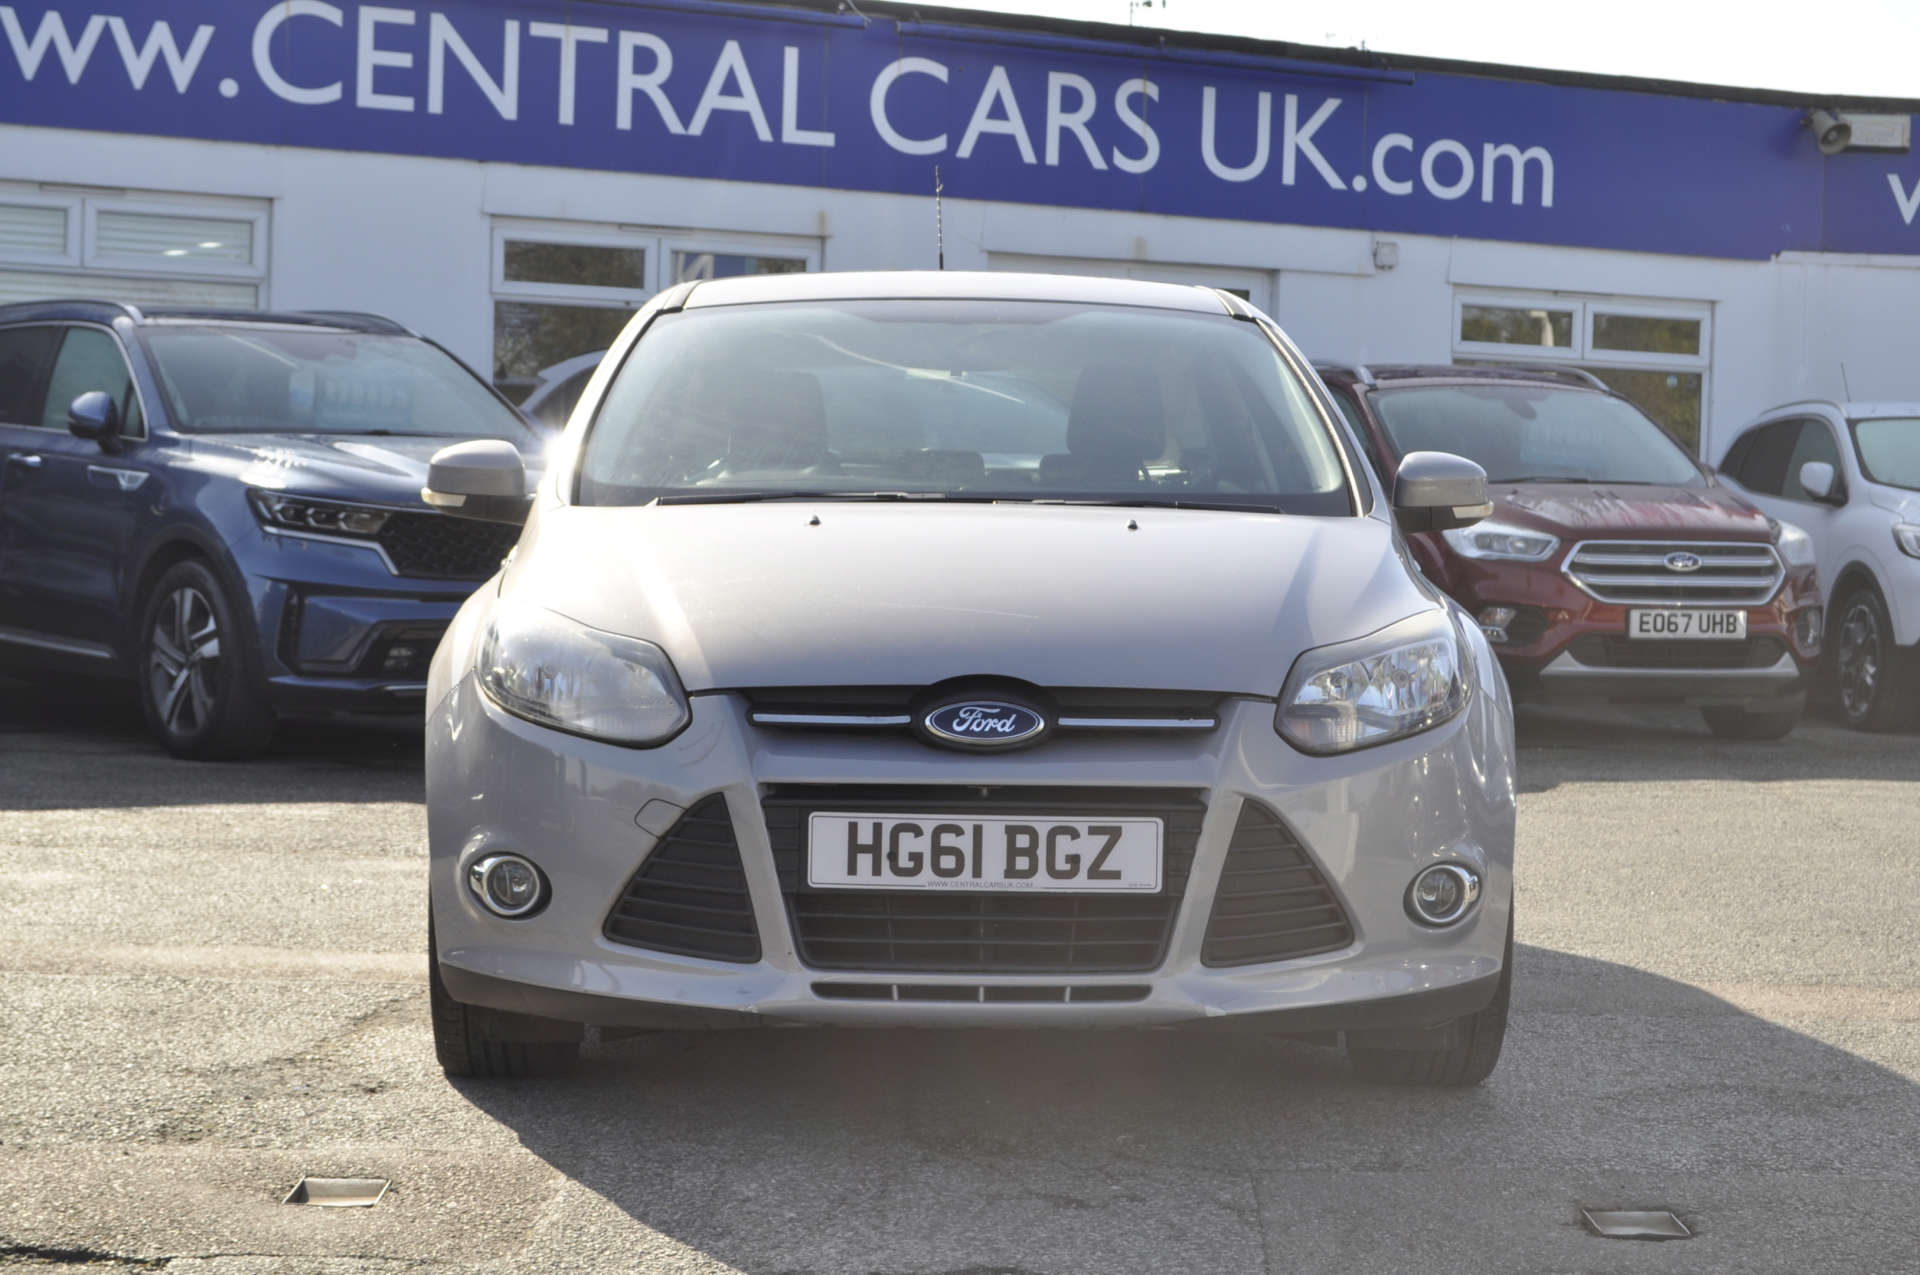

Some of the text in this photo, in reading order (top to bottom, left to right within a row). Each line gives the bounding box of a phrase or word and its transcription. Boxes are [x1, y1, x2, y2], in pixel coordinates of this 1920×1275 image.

[869, 57, 1161, 175] CARS
[1201, 86, 1555, 208] UK.com
[1698, 613, 1738, 634] UHB
[952, 706, 1017, 732] Ford
[846, 821, 1123, 880] HG61 BGZ
